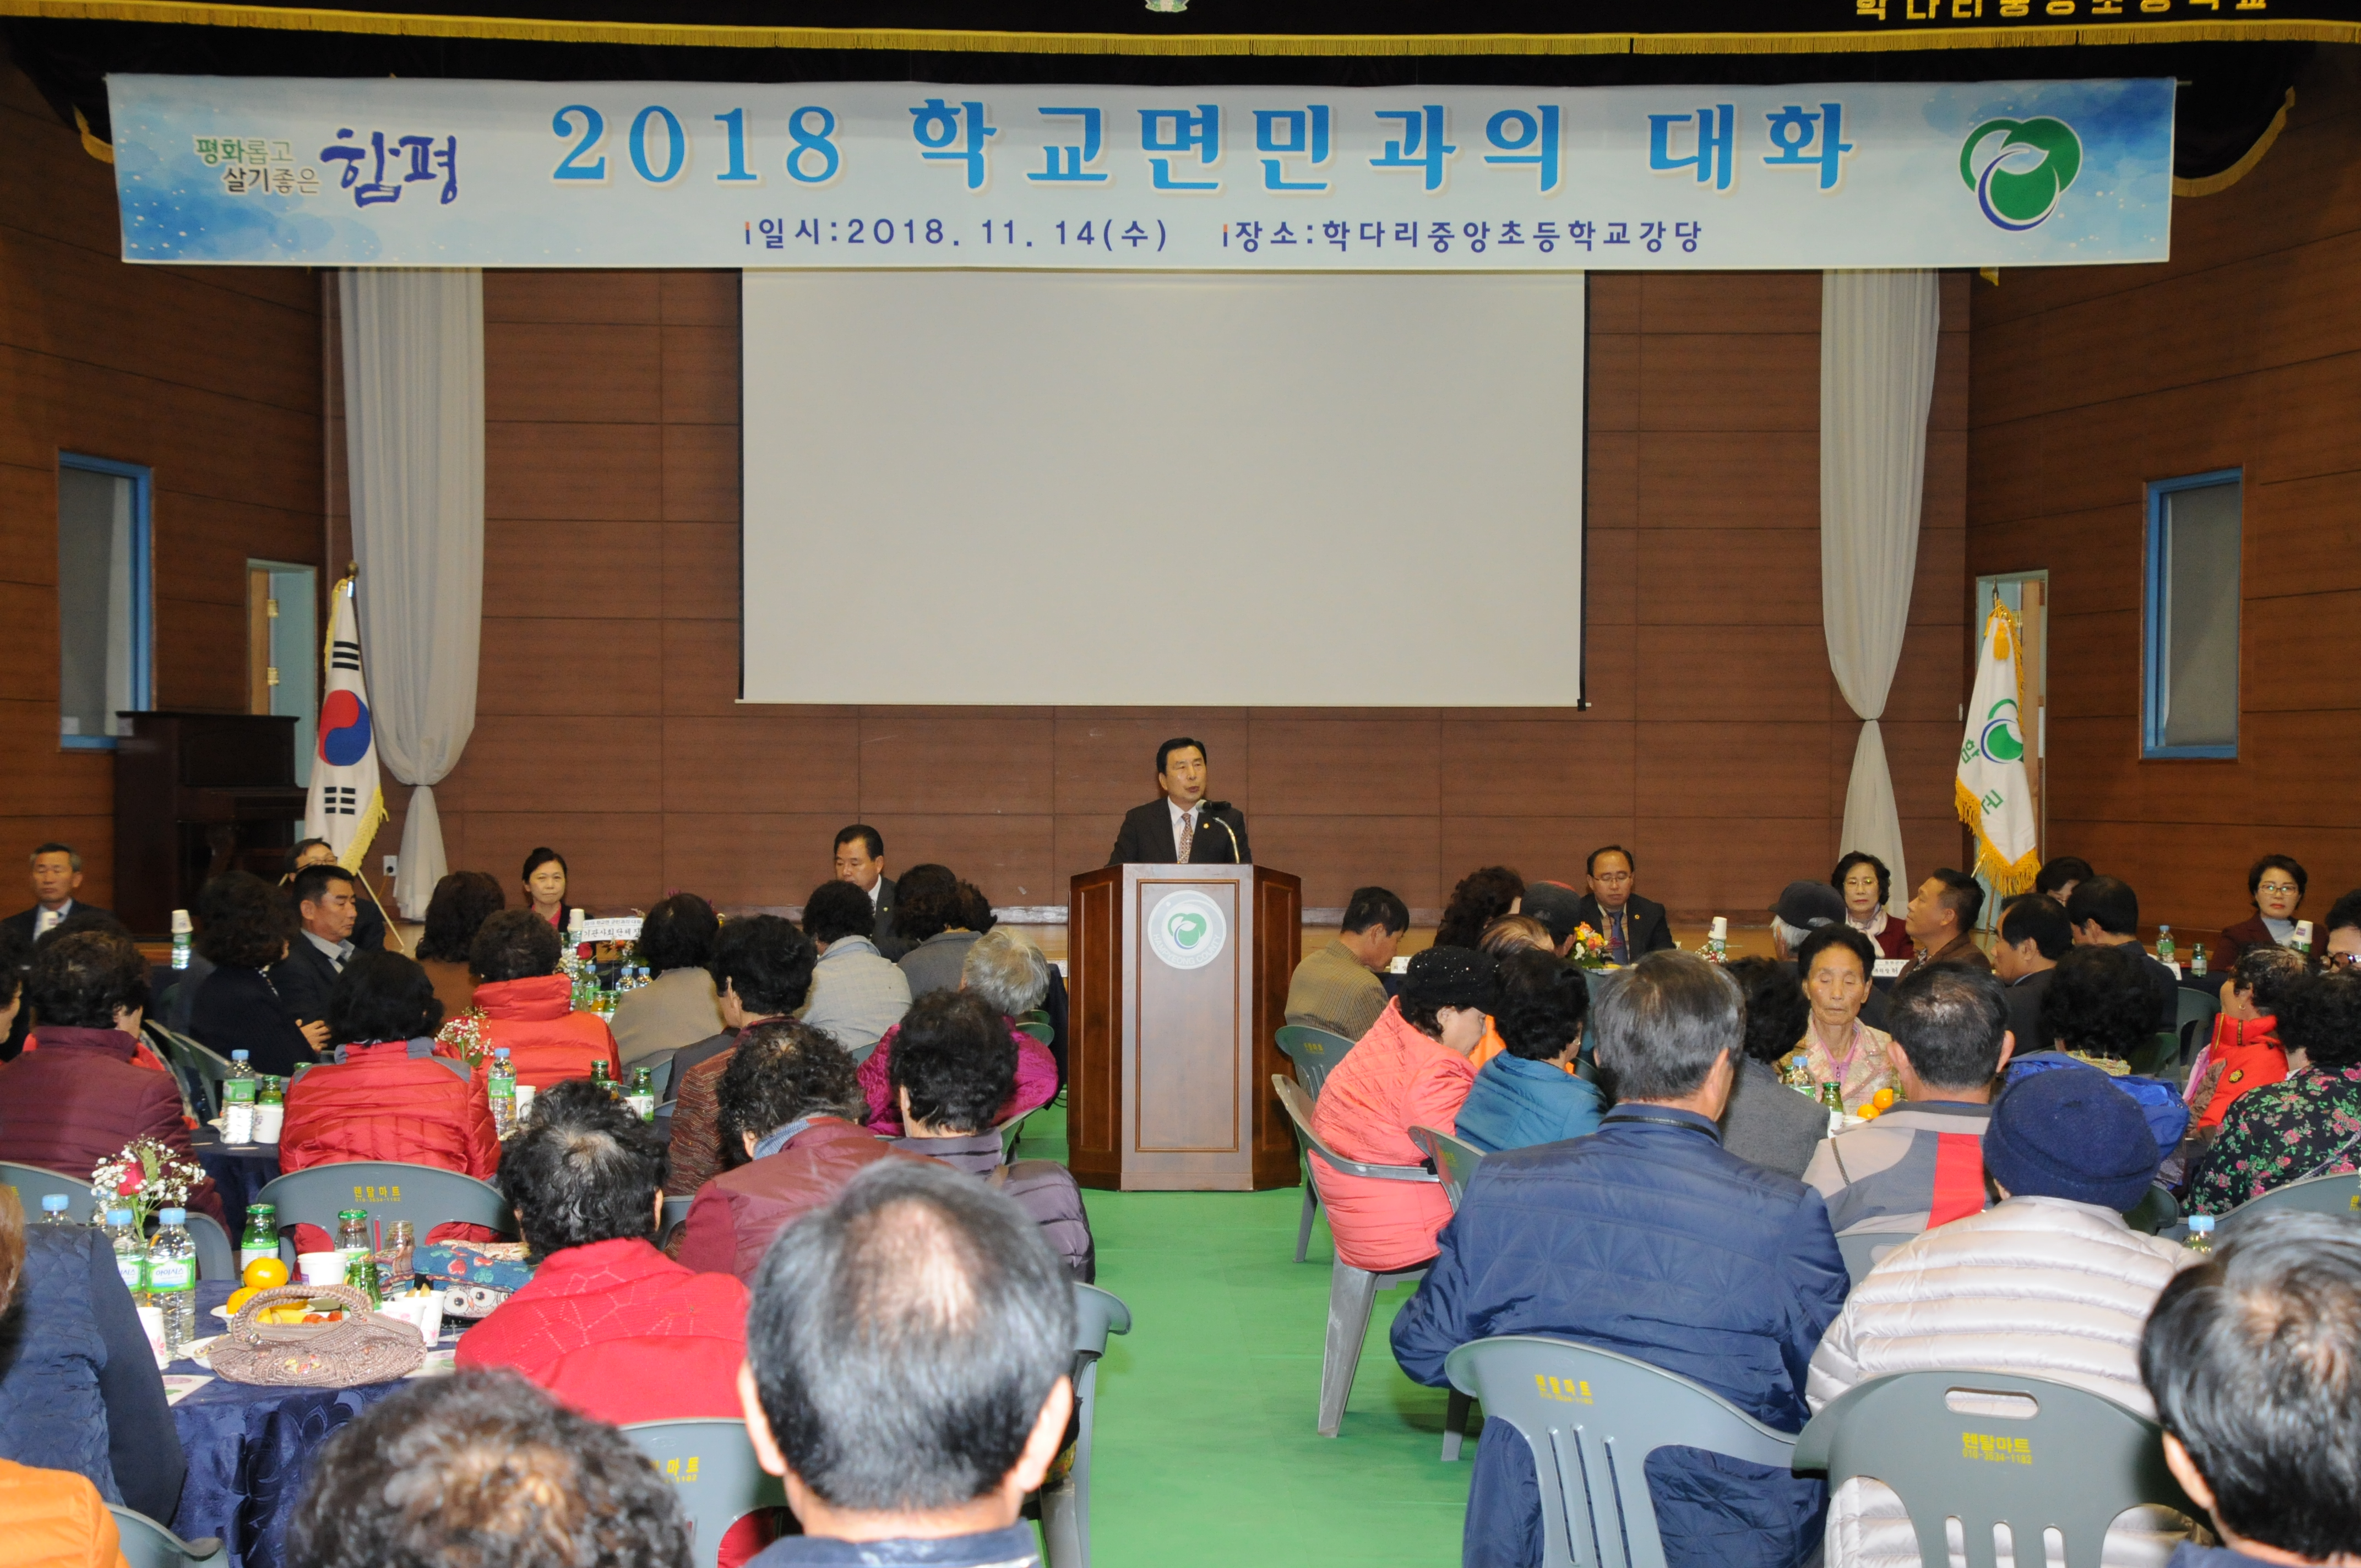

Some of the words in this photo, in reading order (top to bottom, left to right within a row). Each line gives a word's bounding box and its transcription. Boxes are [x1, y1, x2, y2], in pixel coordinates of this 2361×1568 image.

[196, 138, 293, 165] 평화롭고
[552, 105, 840, 184] 2018
[909, 99, 1561, 192] 학교면민과의
[1647, 103, 1854, 190] 대화
[224, 167, 320, 194] 살기좋은
[320, 128, 458, 208] 함평
[1056, 219, 1167, 252] 14(수)
[1154, 934, 1195, 964] HAMPYEONG
[1196, 934, 1221, 962] COUNTY
[156, 1267, 184, 1276] 아이시스
[1962, 1433, 2031, 1453] 렌탈마트
[1962, 1447, 2033, 1465] 010-3634-1182
